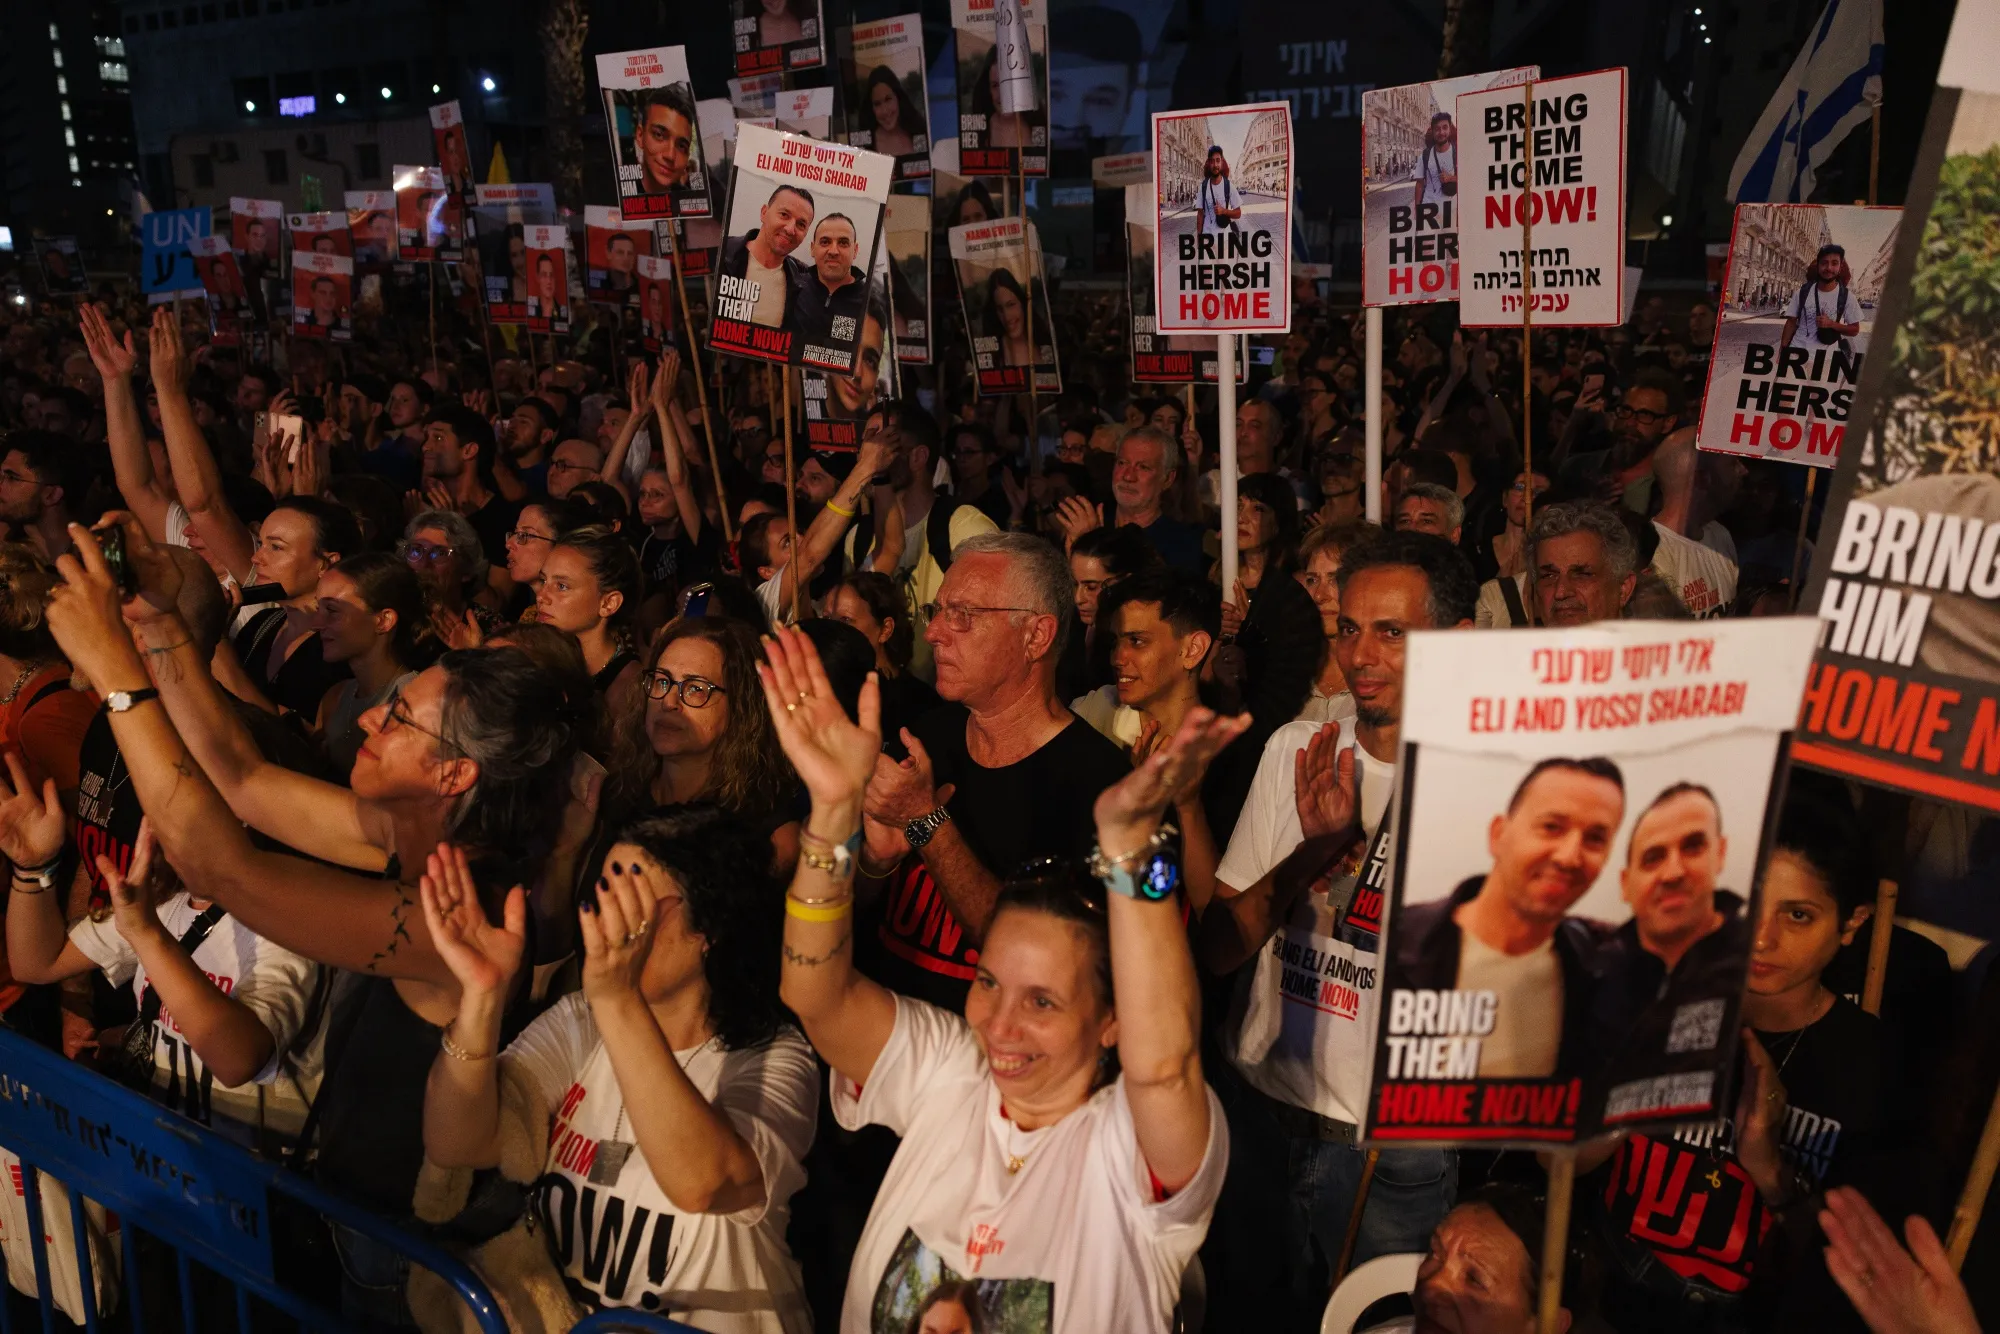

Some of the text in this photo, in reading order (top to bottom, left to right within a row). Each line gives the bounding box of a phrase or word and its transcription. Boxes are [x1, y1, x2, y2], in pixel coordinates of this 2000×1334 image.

[1279, 39, 1347, 75] איתי
[960, 113, 987, 131] BRING
[1485, 93, 1588, 134] BRING
[781, 139, 855, 169] אלי ויוסי שרעבי
[961, 131, 979, 148] HER
[1488, 125, 1581, 161] THEM
[618, 164, 643, 181] BRING
[620, 180, 638, 197] HIM
[756, 153, 868, 192] ELI AND YOSSI SHARABI
[1488, 155, 1583, 191] HOME
[622, 193, 671, 214] HOME NOW!
[1389, 201, 1452, 233] BRI
[1485, 186, 1596, 229] NOW!
[152, 212, 201, 247] UN
[1179, 230, 1272, 260] BRING
[1389, 233, 1459, 264] HER
[719, 274, 760, 303] BRING
[1179, 262, 1270, 291] HERSH
[1389, 264, 1459, 295] HO
[1543, 268, 1601, 287] אותם
[718, 295, 754, 323] THEM
[1180, 292, 1270, 320] HOME
[1501, 293, 1569, 312] עכשיו!
[713, 317, 793, 355] HOME NOW!
[1134, 315, 1156, 333] BRIN
[803, 350, 851, 369] FAMILIES FORUM
[1134, 334, 1152, 352] HER
[1136, 353, 1162, 373] HOME
[1163, 350, 1194, 373] NOW!
[1743, 343, 1865, 385] BRIN
[803, 379, 827, 399] BRING
[1736, 379, 1856, 421] HERS
[805, 399, 821, 419] HIM
[831, 421, 857, 444] NOW!
[1730, 413, 1848, 457] HOM
[1831, 500, 2000, 599] BRING
[1683, 577, 1707, 599] BRING
[1817, 578, 1932, 668] HIM
[1531, 646, 1613, 685] שרעבי
[1677, 638, 1716, 677] אלי
[1470, 681, 1748, 734] ELI AND YOSSI SHARABI
[1797, 661, 1962, 763] HOME
[1353, 887, 1385, 920] HO
[1272, 934, 1377, 990] BRING ELI AND YOS
[1280, 968, 1359, 1016] HOME NOW!
[1388, 988, 1499, 1036] BRING
[1385, 1035, 1482, 1080] THEM
[1376, 1082, 1478, 1125] HOME
[1480, 1076, 1582, 1126] NOW!
[555, 1130, 599, 1177] HOM
[540, 1172, 676, 1310] OW!
